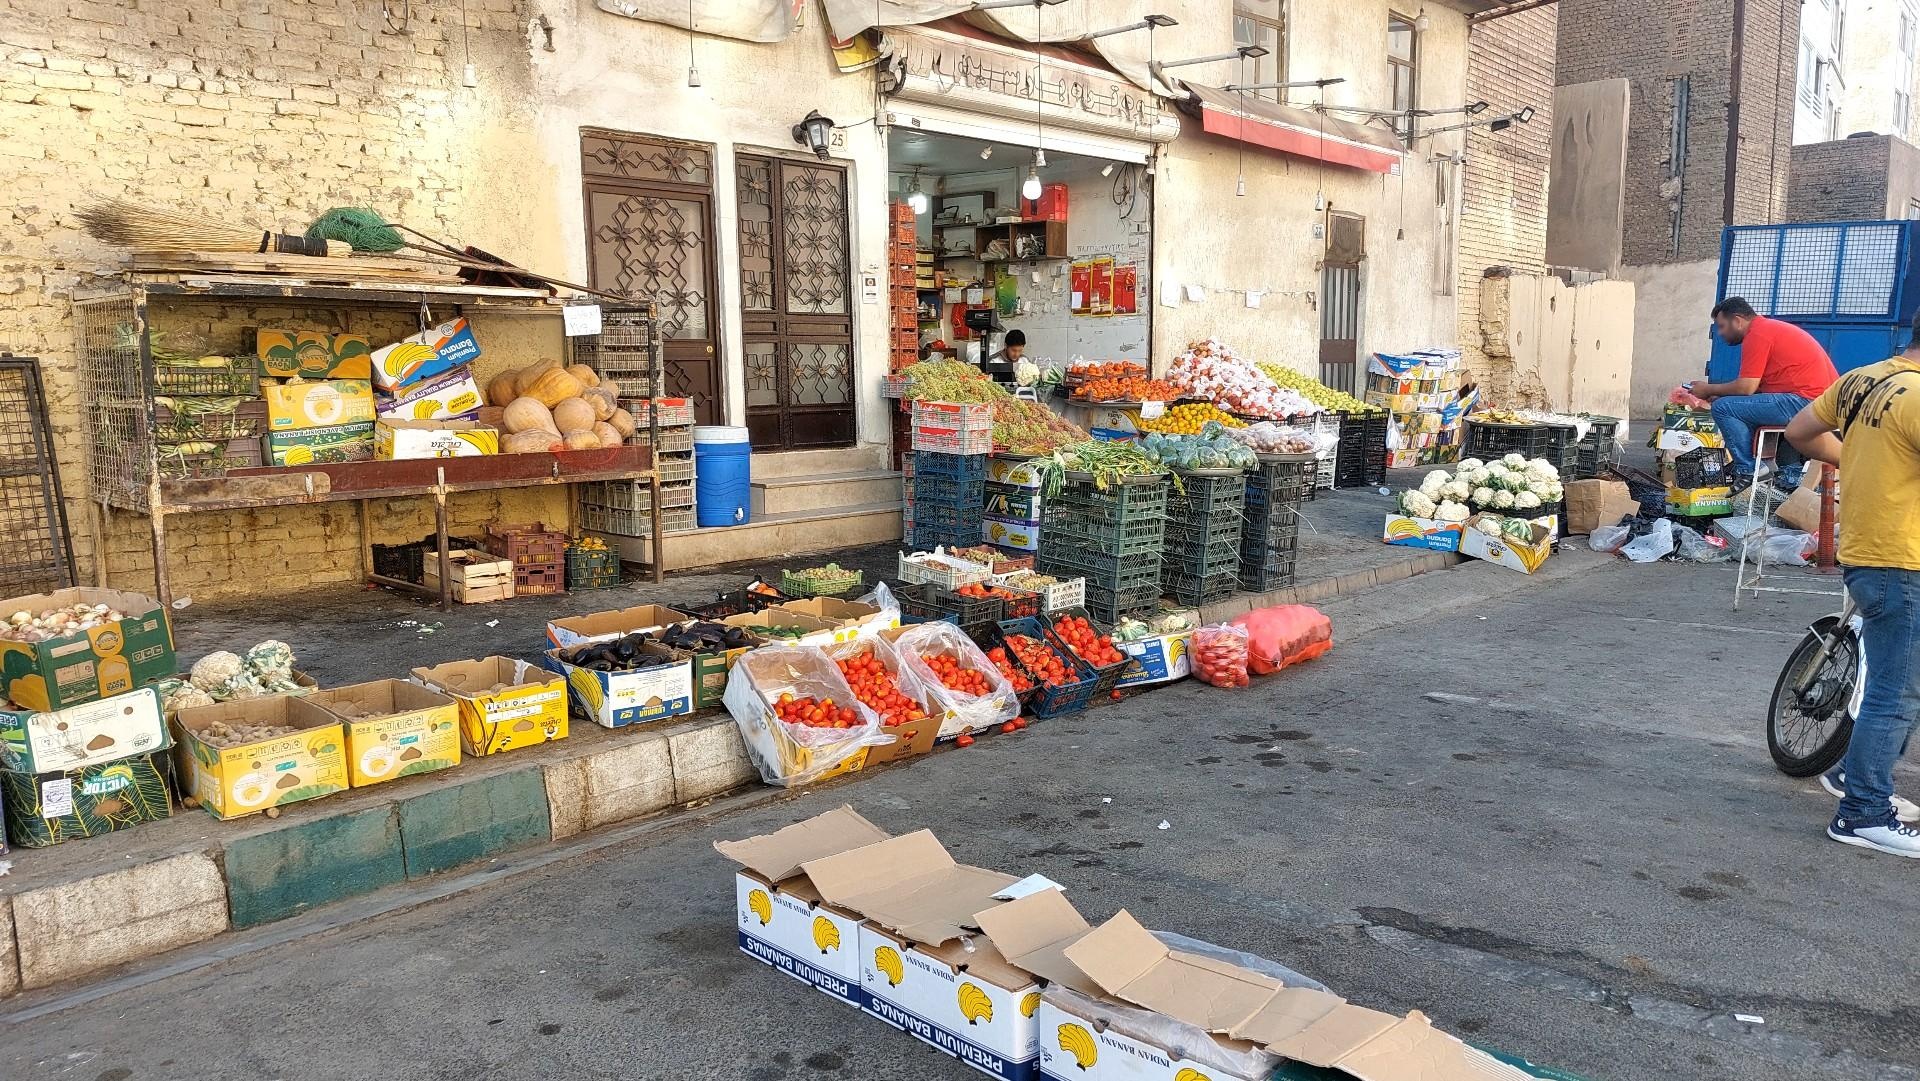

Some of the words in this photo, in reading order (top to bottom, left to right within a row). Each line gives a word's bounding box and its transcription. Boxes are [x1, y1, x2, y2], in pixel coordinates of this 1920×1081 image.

[831, 133, 844, 147] 25
[440, 338, 474, 356] Banana
[448, 346, 477, 361] Premium
[438, 375, 463, 391] PREMIUM
[273, 430, 304, 439] BANANA
[305, 426, 343, 436] CAVENDISH
[344, 423, 373, 432] PREMIUM
[1695, 498, 1727, 507] BANANA
[1426, 534, 1452, 543] Banana
[1428, 541, 1452, 549] Premium
[83, 779, 129, 795] VICTOR
[794, 904, 811, 918] INDIAN
[746, 937, 793, 970] BANANAS
[905, 955, 931, 973] BANANA
[795, 964, 848, 997] PREMIUM
[932, 967, 955, 983] INDIAN
[872, 997, 932, 1037] BANANAS
[1099, 1034, 1136, 1055] BANANA
[935, 1034, 1003, 1074] PREMIUM
[1137, 1050, 1171, 1068] INDIAN
